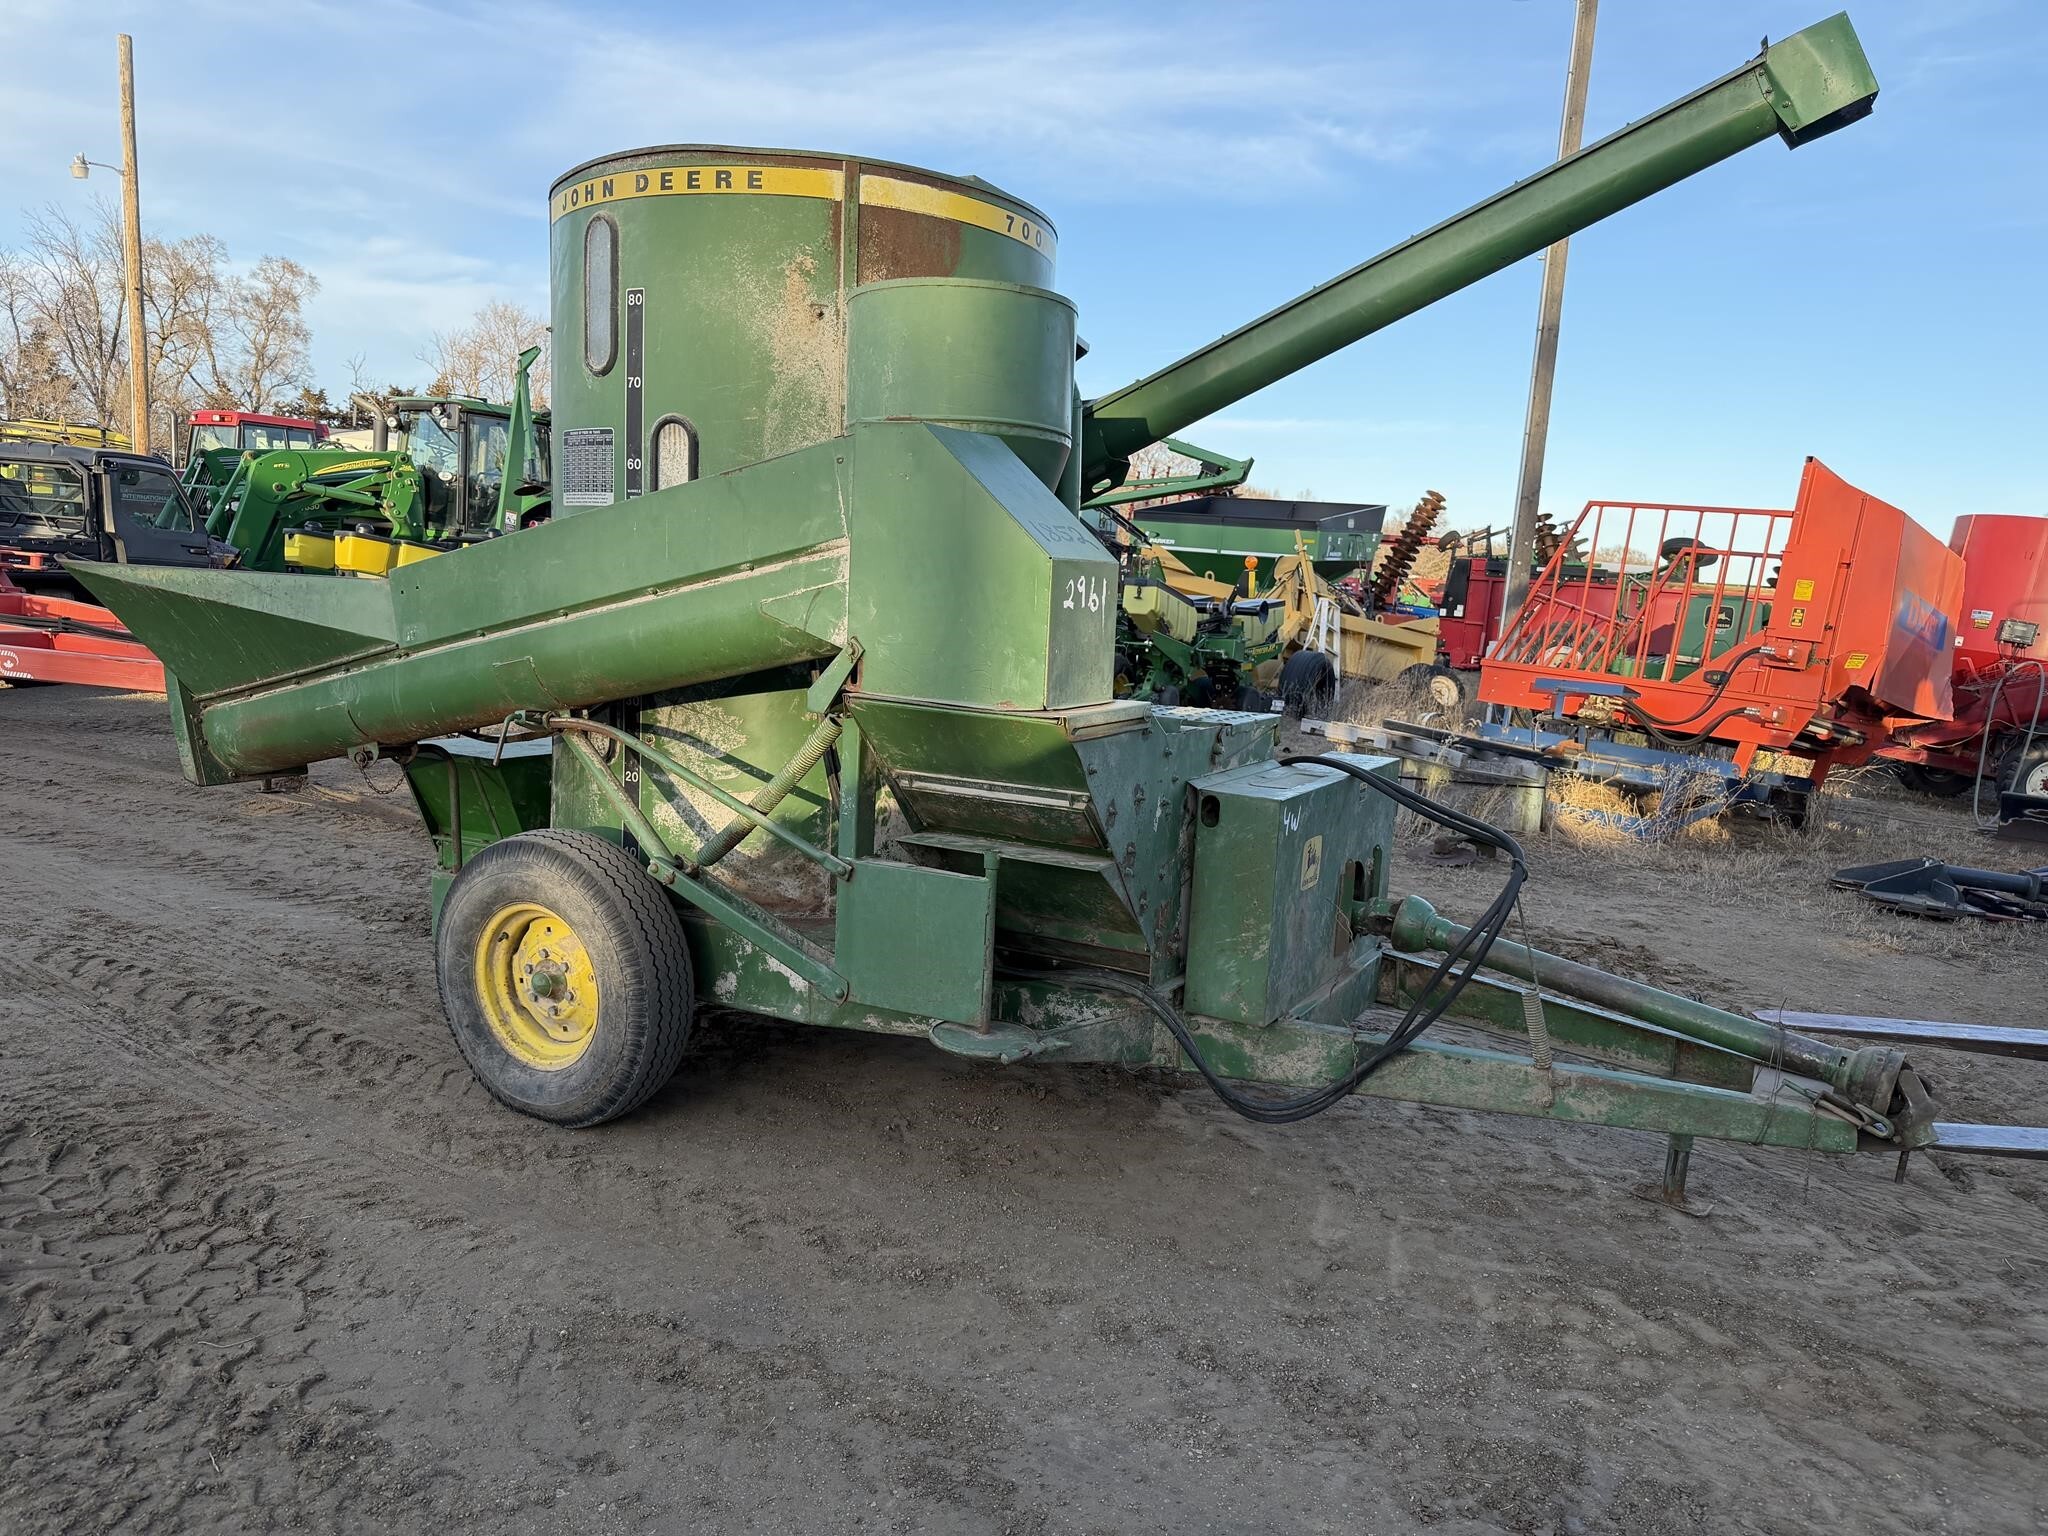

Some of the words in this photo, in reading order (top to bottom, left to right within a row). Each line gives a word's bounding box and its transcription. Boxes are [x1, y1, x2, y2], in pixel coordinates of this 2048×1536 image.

[562, 178, 614, 211] JOHN
[635, 170, 763, 193] DEERE
[1006, 214, 1042, 248] 700
[628, 293, 642, 306] 80
[627, 376, 642, 388] 70
[627, 458, 642, 470] 60
[1063, 575, 1107, 618] 2961
[625, 770, 639, 783] 20
